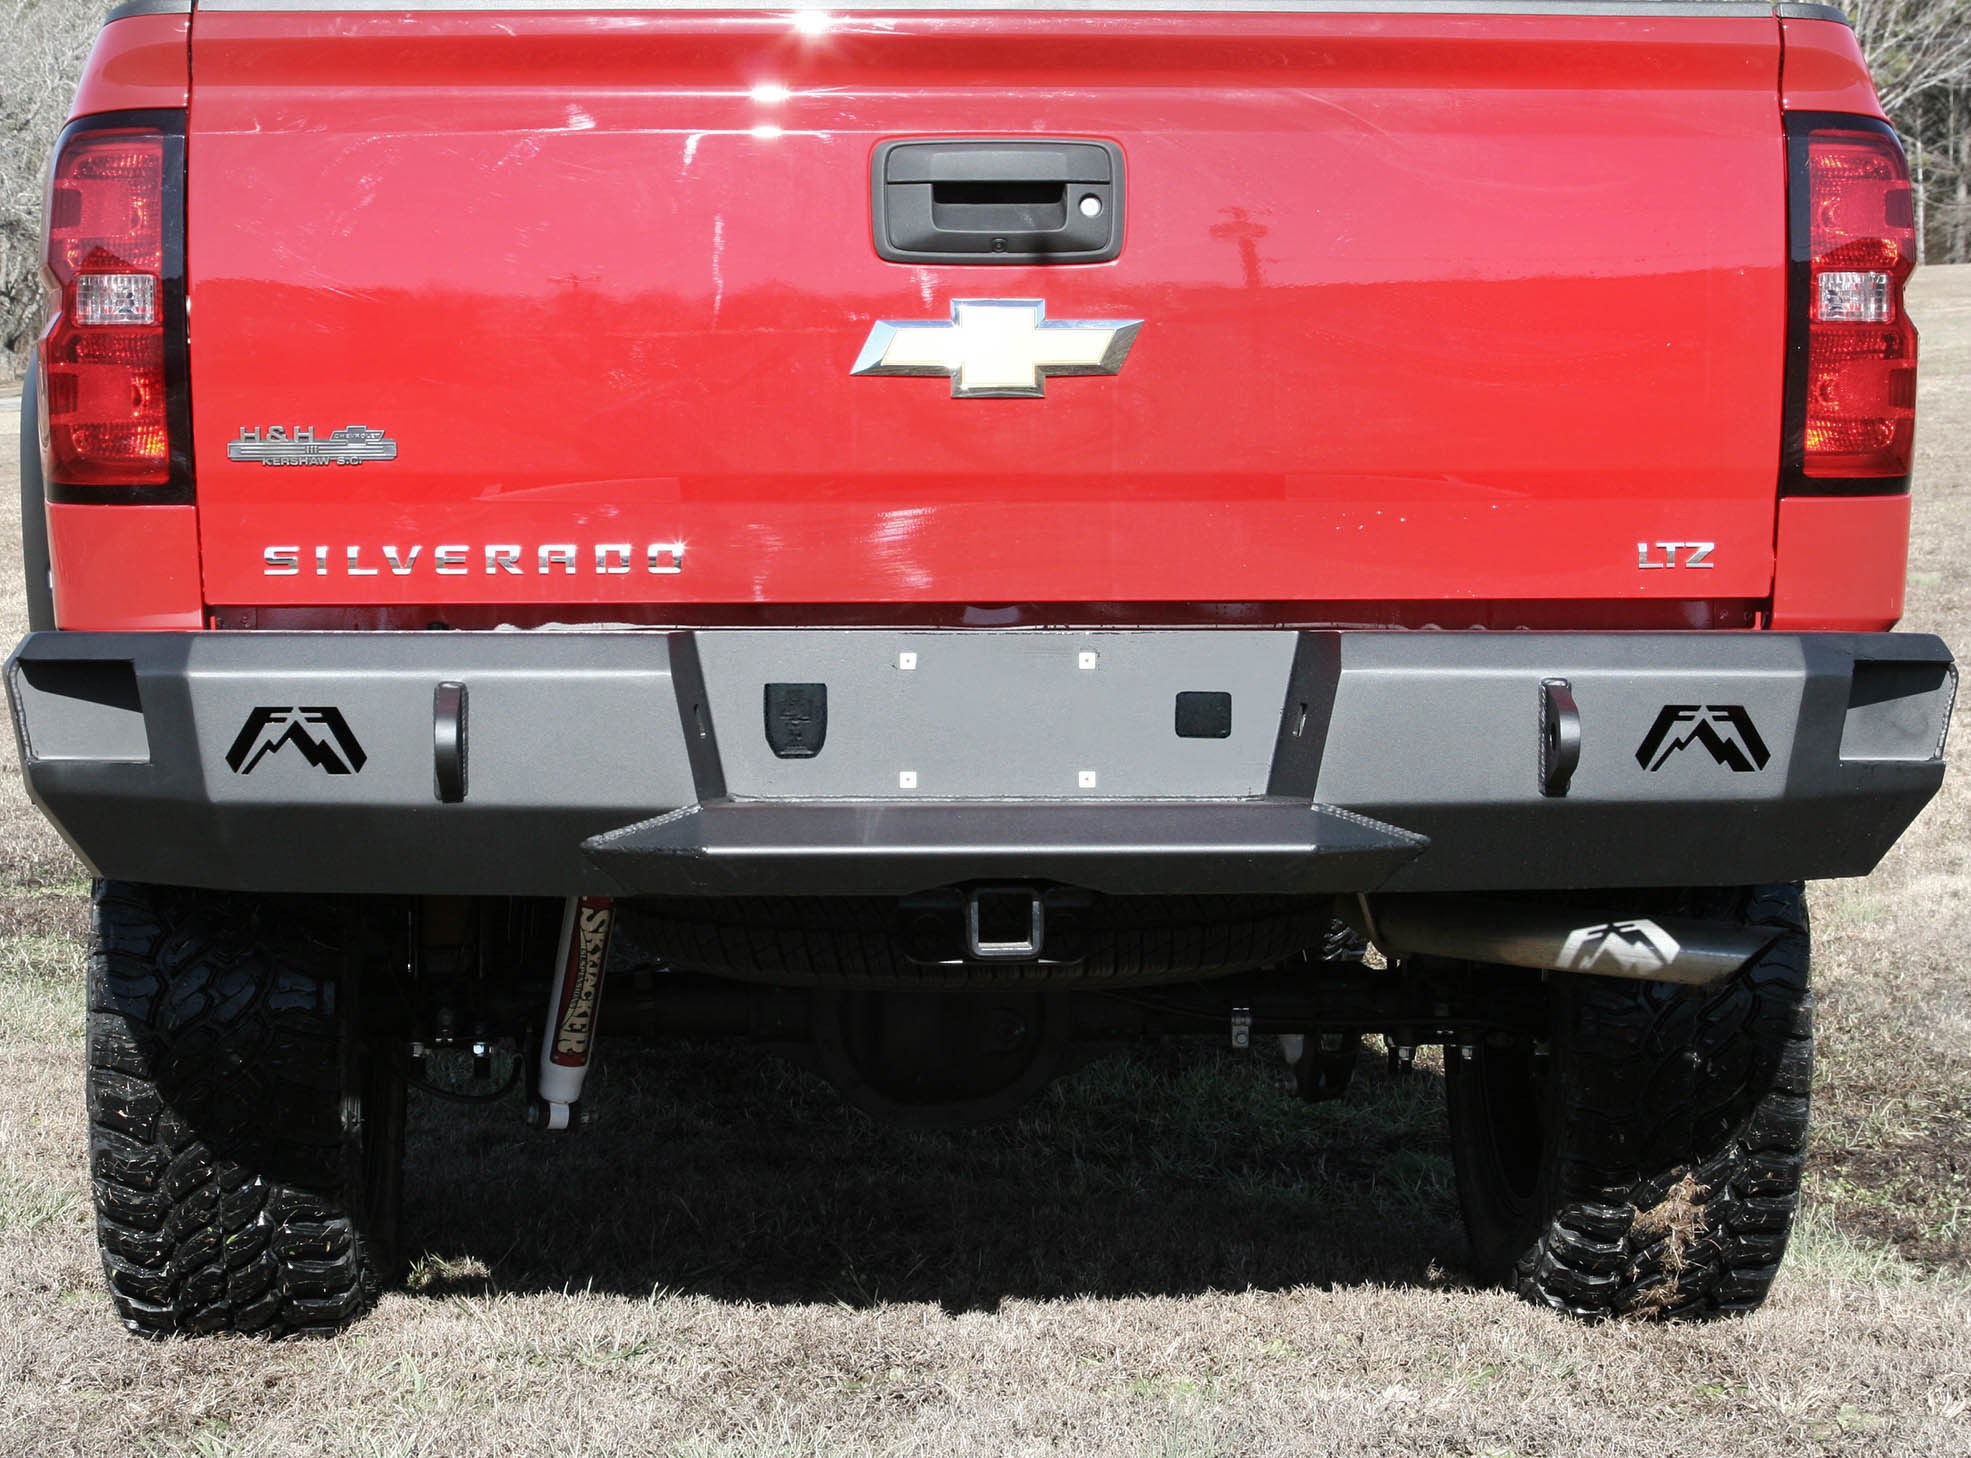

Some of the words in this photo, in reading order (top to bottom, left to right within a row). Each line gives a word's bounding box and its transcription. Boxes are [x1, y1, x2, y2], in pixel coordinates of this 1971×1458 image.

[262, 456, 330, 466] KERSHAW
[263, 544, 684, 576] SILVERADO
[1637, 542, 1715, 568] LTZ
[557, 907, 611, 1054] SKYJACKER
